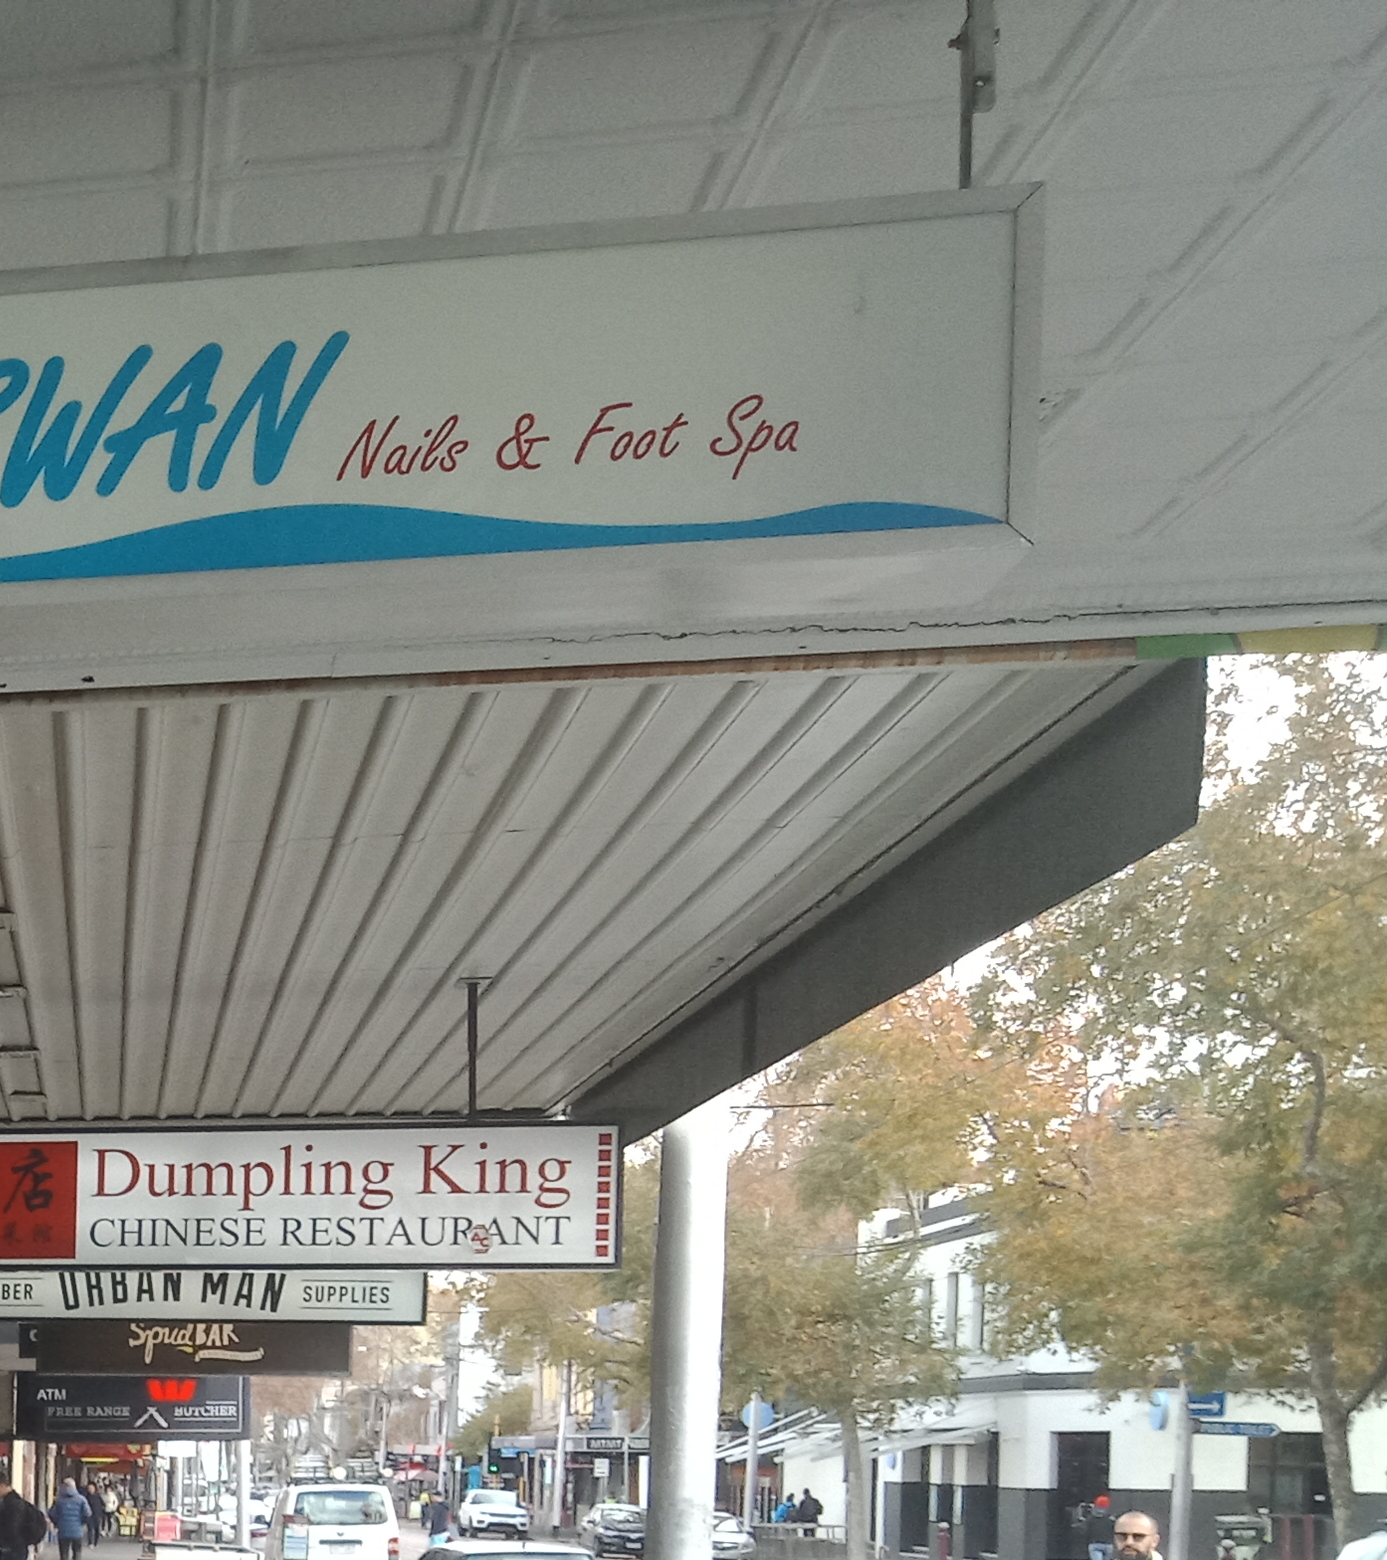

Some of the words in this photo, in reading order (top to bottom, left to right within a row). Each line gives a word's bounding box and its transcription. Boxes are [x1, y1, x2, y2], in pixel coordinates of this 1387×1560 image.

[337, 415, 470, 482] Nails
[494, 415, 549, 471] &
[573, 402, 688, 467] Foot
[709, 395, 800, 480] Spa
[91, 1144, 395, 1211] Dumpling
[416, 1142, 572, 1209] King
[89, 1217, 267, 1248] CHINESE
[280, 1216, 571, 1247] RESTAURANT
[58, 1271, 182, 1311] URBAN
[201, 1272, 287, 1313] MAN
[302, 1286, 390, 1304] SUPPLIES
[37, 1389, 66, 1401] ATM
[47, 1406, 82, 1417] FREE
[86, 1406, 130, 1417] RANGE
[174, 1406, 237, 1418] BUTCHER
